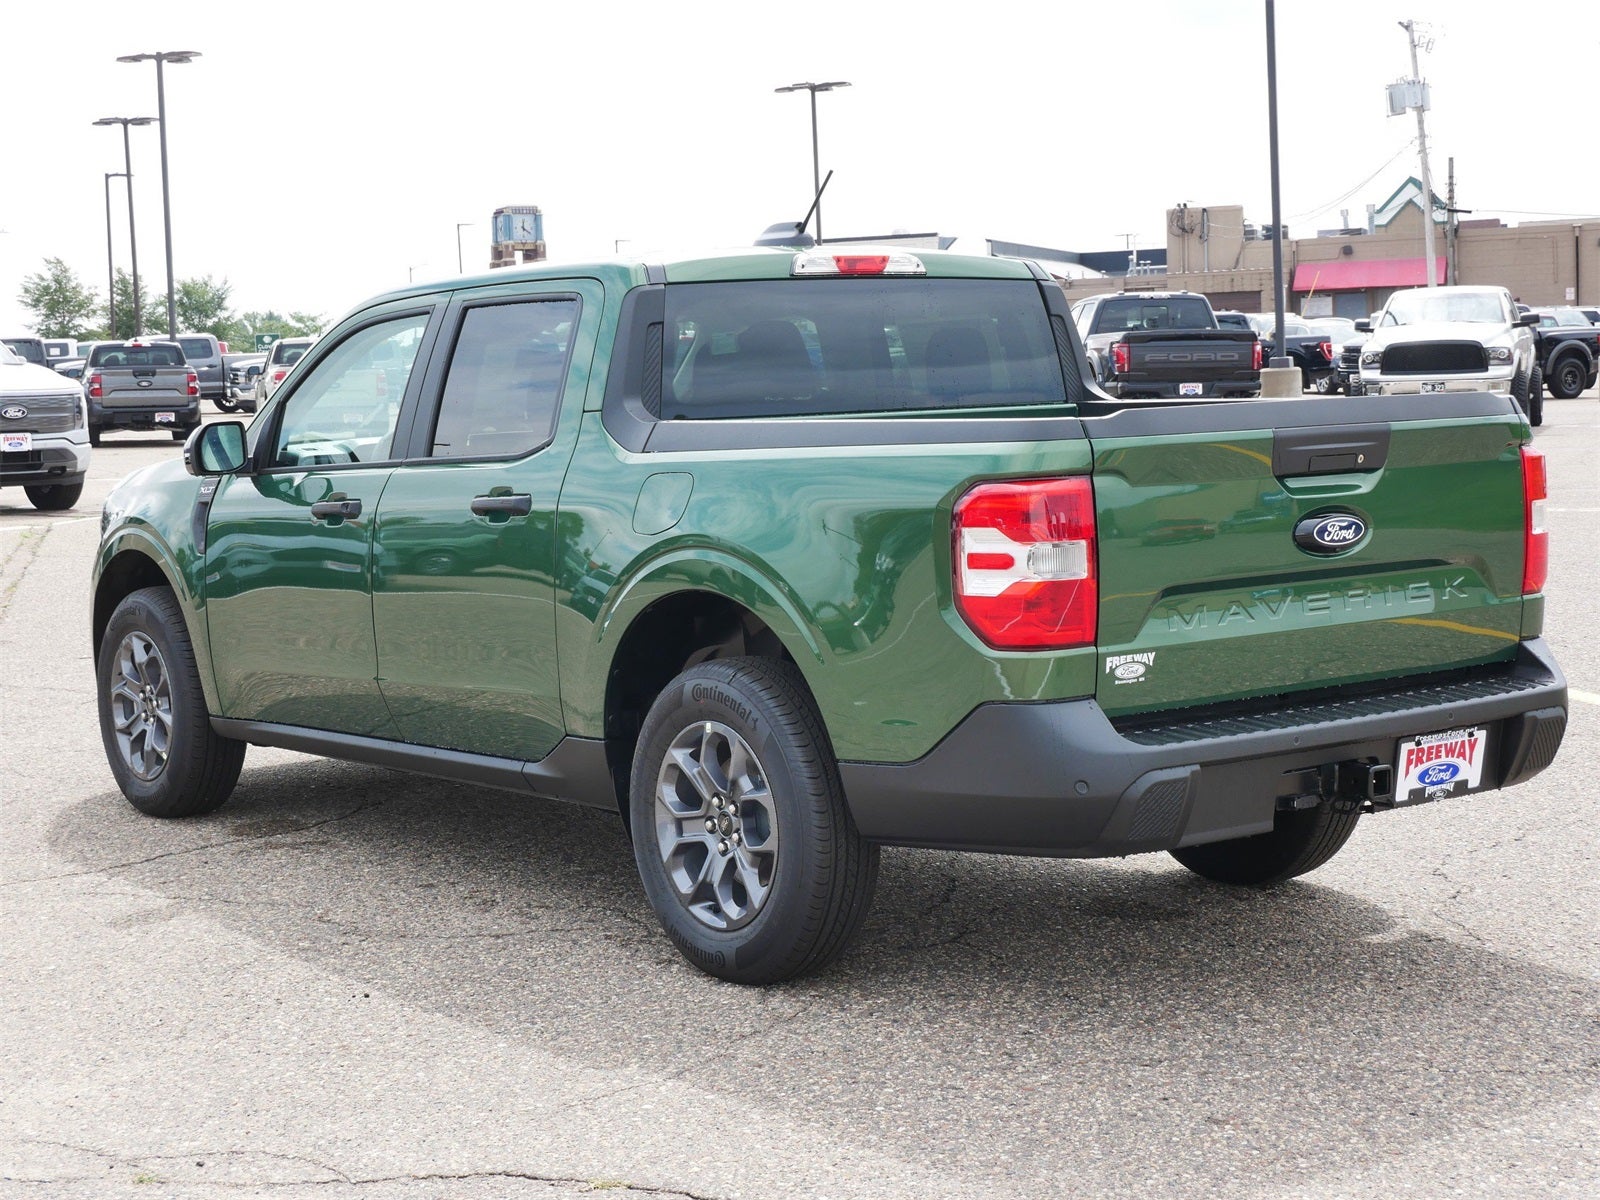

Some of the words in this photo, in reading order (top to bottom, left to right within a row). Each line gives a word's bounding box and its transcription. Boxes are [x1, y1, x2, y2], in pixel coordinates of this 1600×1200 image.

[1145, 352, 1239, 361] FORD
[1324, 521, 1356, 541] Ford
[1167, 576, 1468, 632] MAVERICK
[1105, 652, 1156, 674] FREEWAY
[692, 683, 752, 723] Continental
[1404, 738, 1479, 781] FREEWAY
[1424, 765, 1453, 783] Ford
